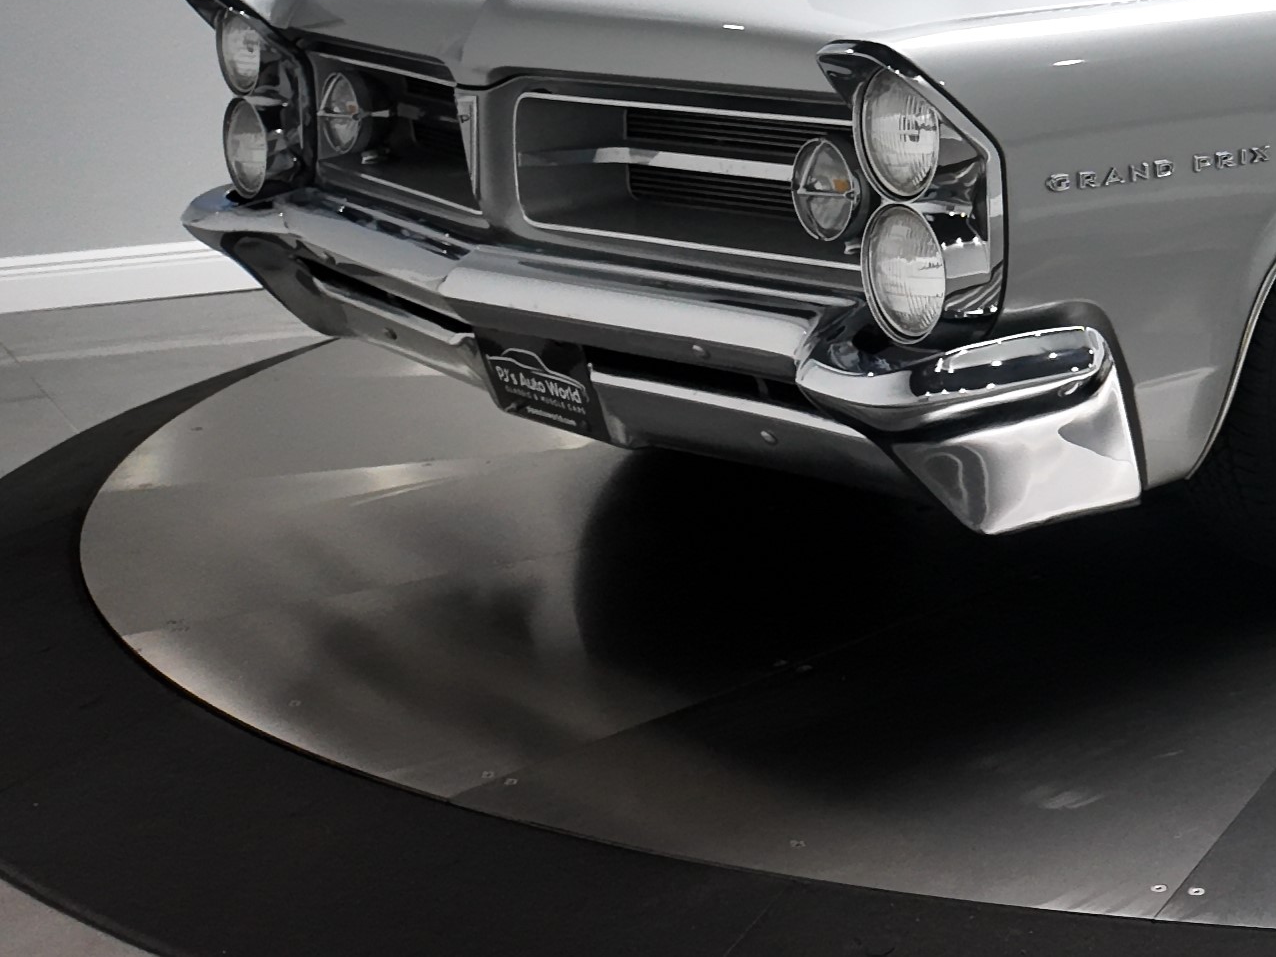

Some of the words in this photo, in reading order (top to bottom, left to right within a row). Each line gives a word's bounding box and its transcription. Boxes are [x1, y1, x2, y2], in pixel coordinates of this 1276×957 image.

[1045, 159, 1175, 192] GRAND
[1193, 145, 1271, 173] PRIX
[519, 372, 546, 393] Auto
[545, 379, 582, 404] World
